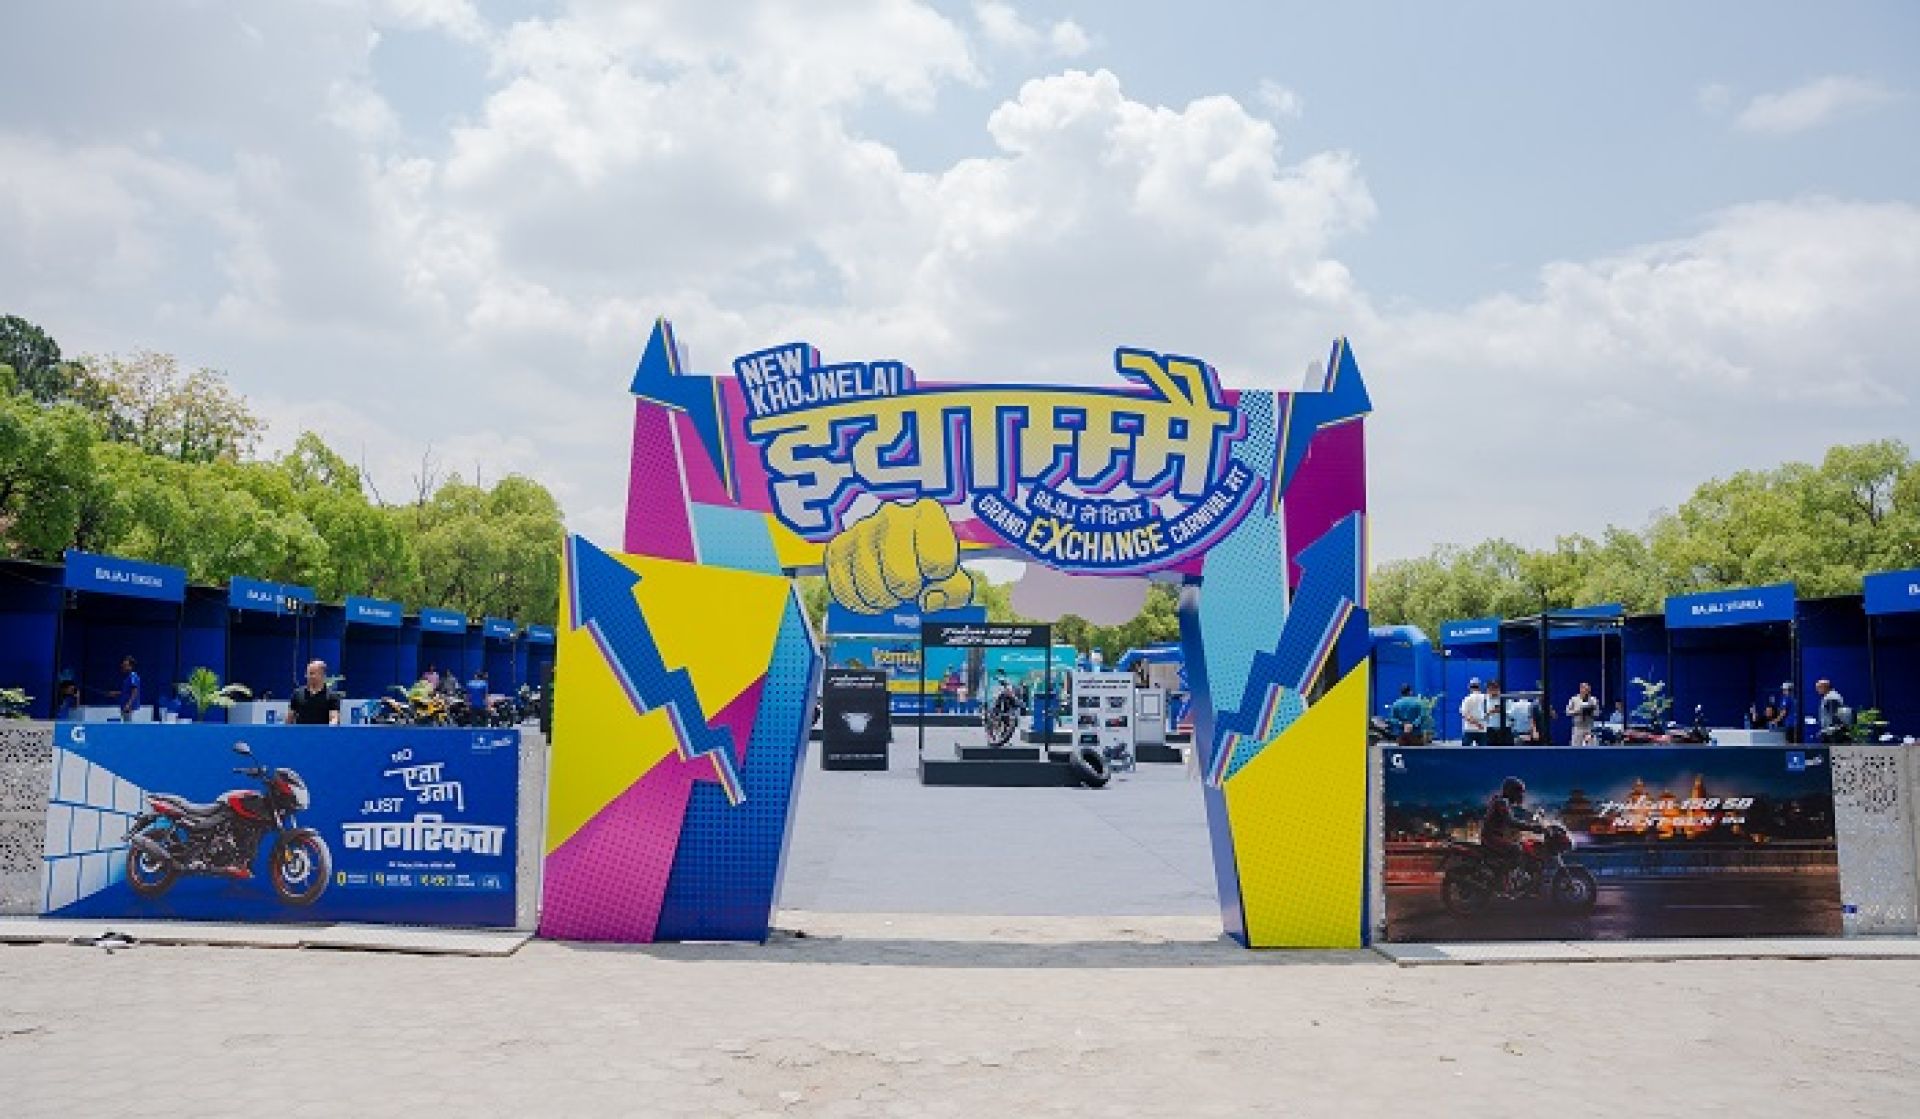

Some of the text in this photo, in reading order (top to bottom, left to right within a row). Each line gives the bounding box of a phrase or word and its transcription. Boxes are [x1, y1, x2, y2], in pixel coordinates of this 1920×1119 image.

[740, 347, 802, 388] NEW
[751, 366, 898, 417] KHOJNELAI
[978, 494, 1027, 539] GRAND
[1025, 516, 1169, 562] EXCHANGE
[1169, 490, 1234, 544] CARNIVAL
[361, 798, 404, 815] JUST
[342, 813, 506, 856] नागरिकता
